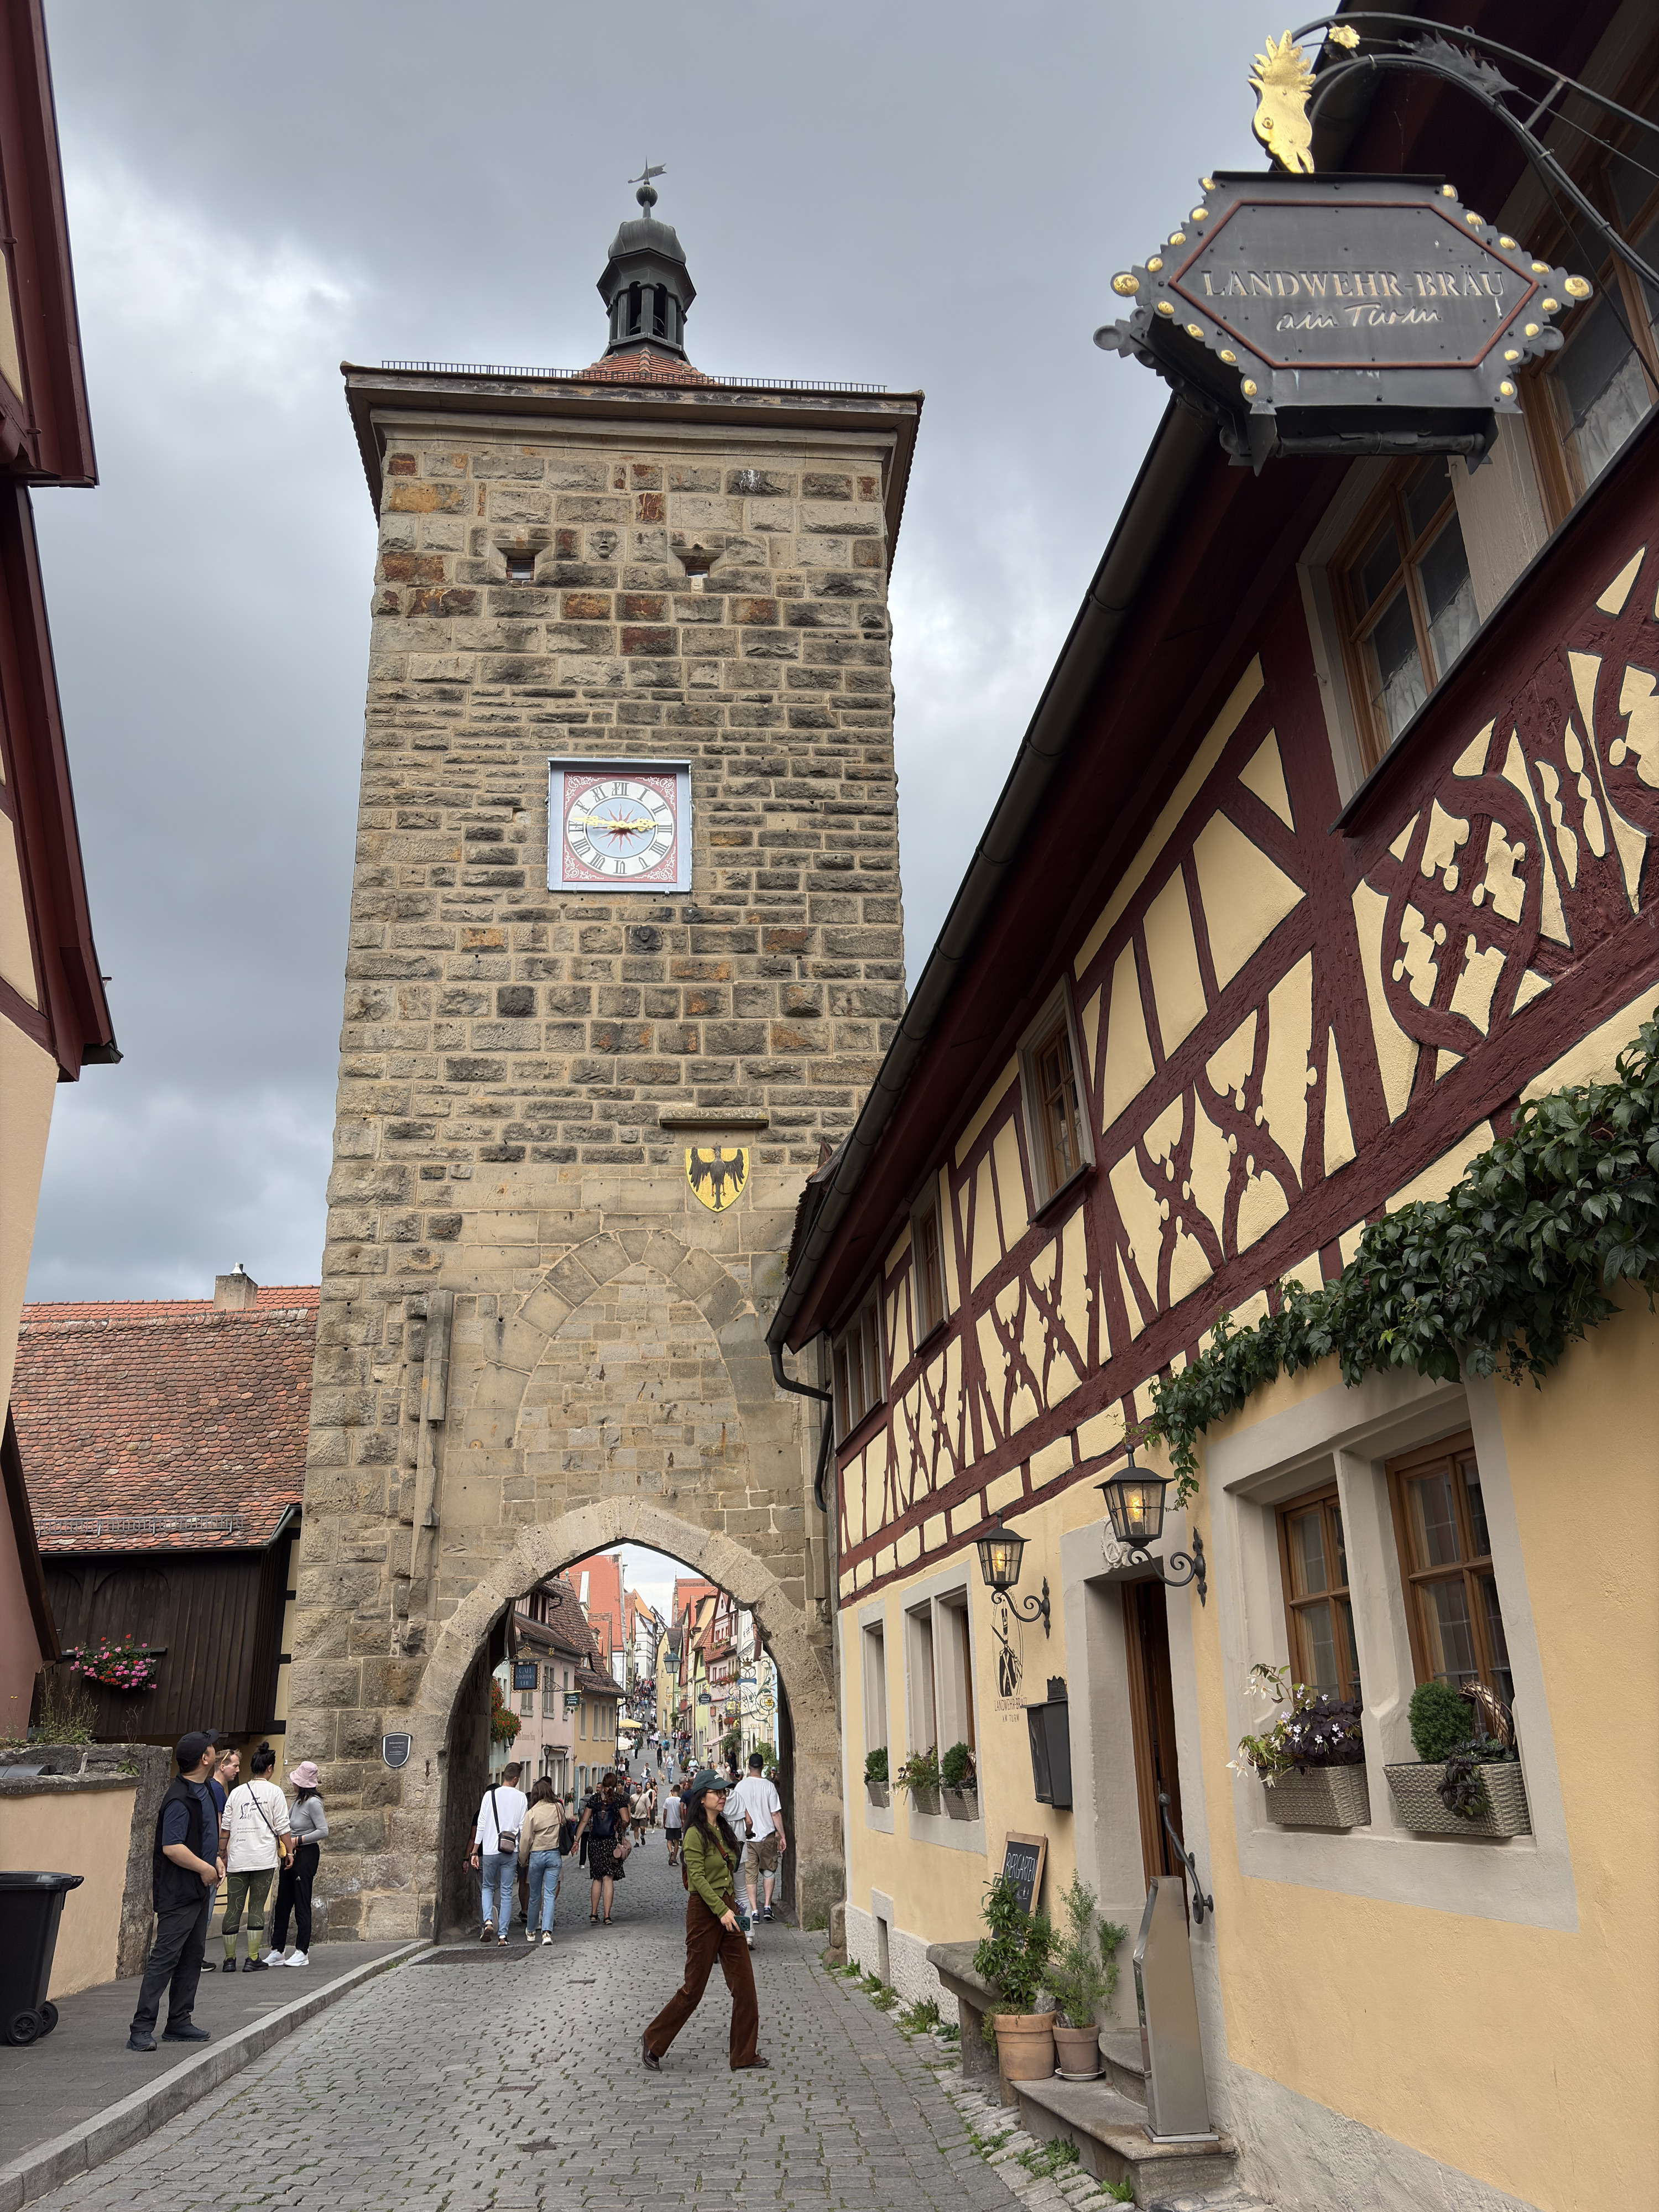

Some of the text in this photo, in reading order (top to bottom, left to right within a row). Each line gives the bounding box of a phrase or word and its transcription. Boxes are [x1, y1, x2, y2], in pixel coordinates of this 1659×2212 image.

[1201, 265, 1504, 296] LANDWEHR-BRÄU
[1276, 302, 1442, 331] am Turm
[590, 785, 609, 803] XI
[612, 782, 630, 796] XII
[637, 787, 650, 802] I
[575, 800, 591, 814] X
[651, 802, 669, 816] II
[657, 823, 672, 836] III
[571, 836, 591, 858] VIII
[587, 852, 606, 870] VII
[613, 860, 627, 874] VI
[638, 857, 650, 870] V
